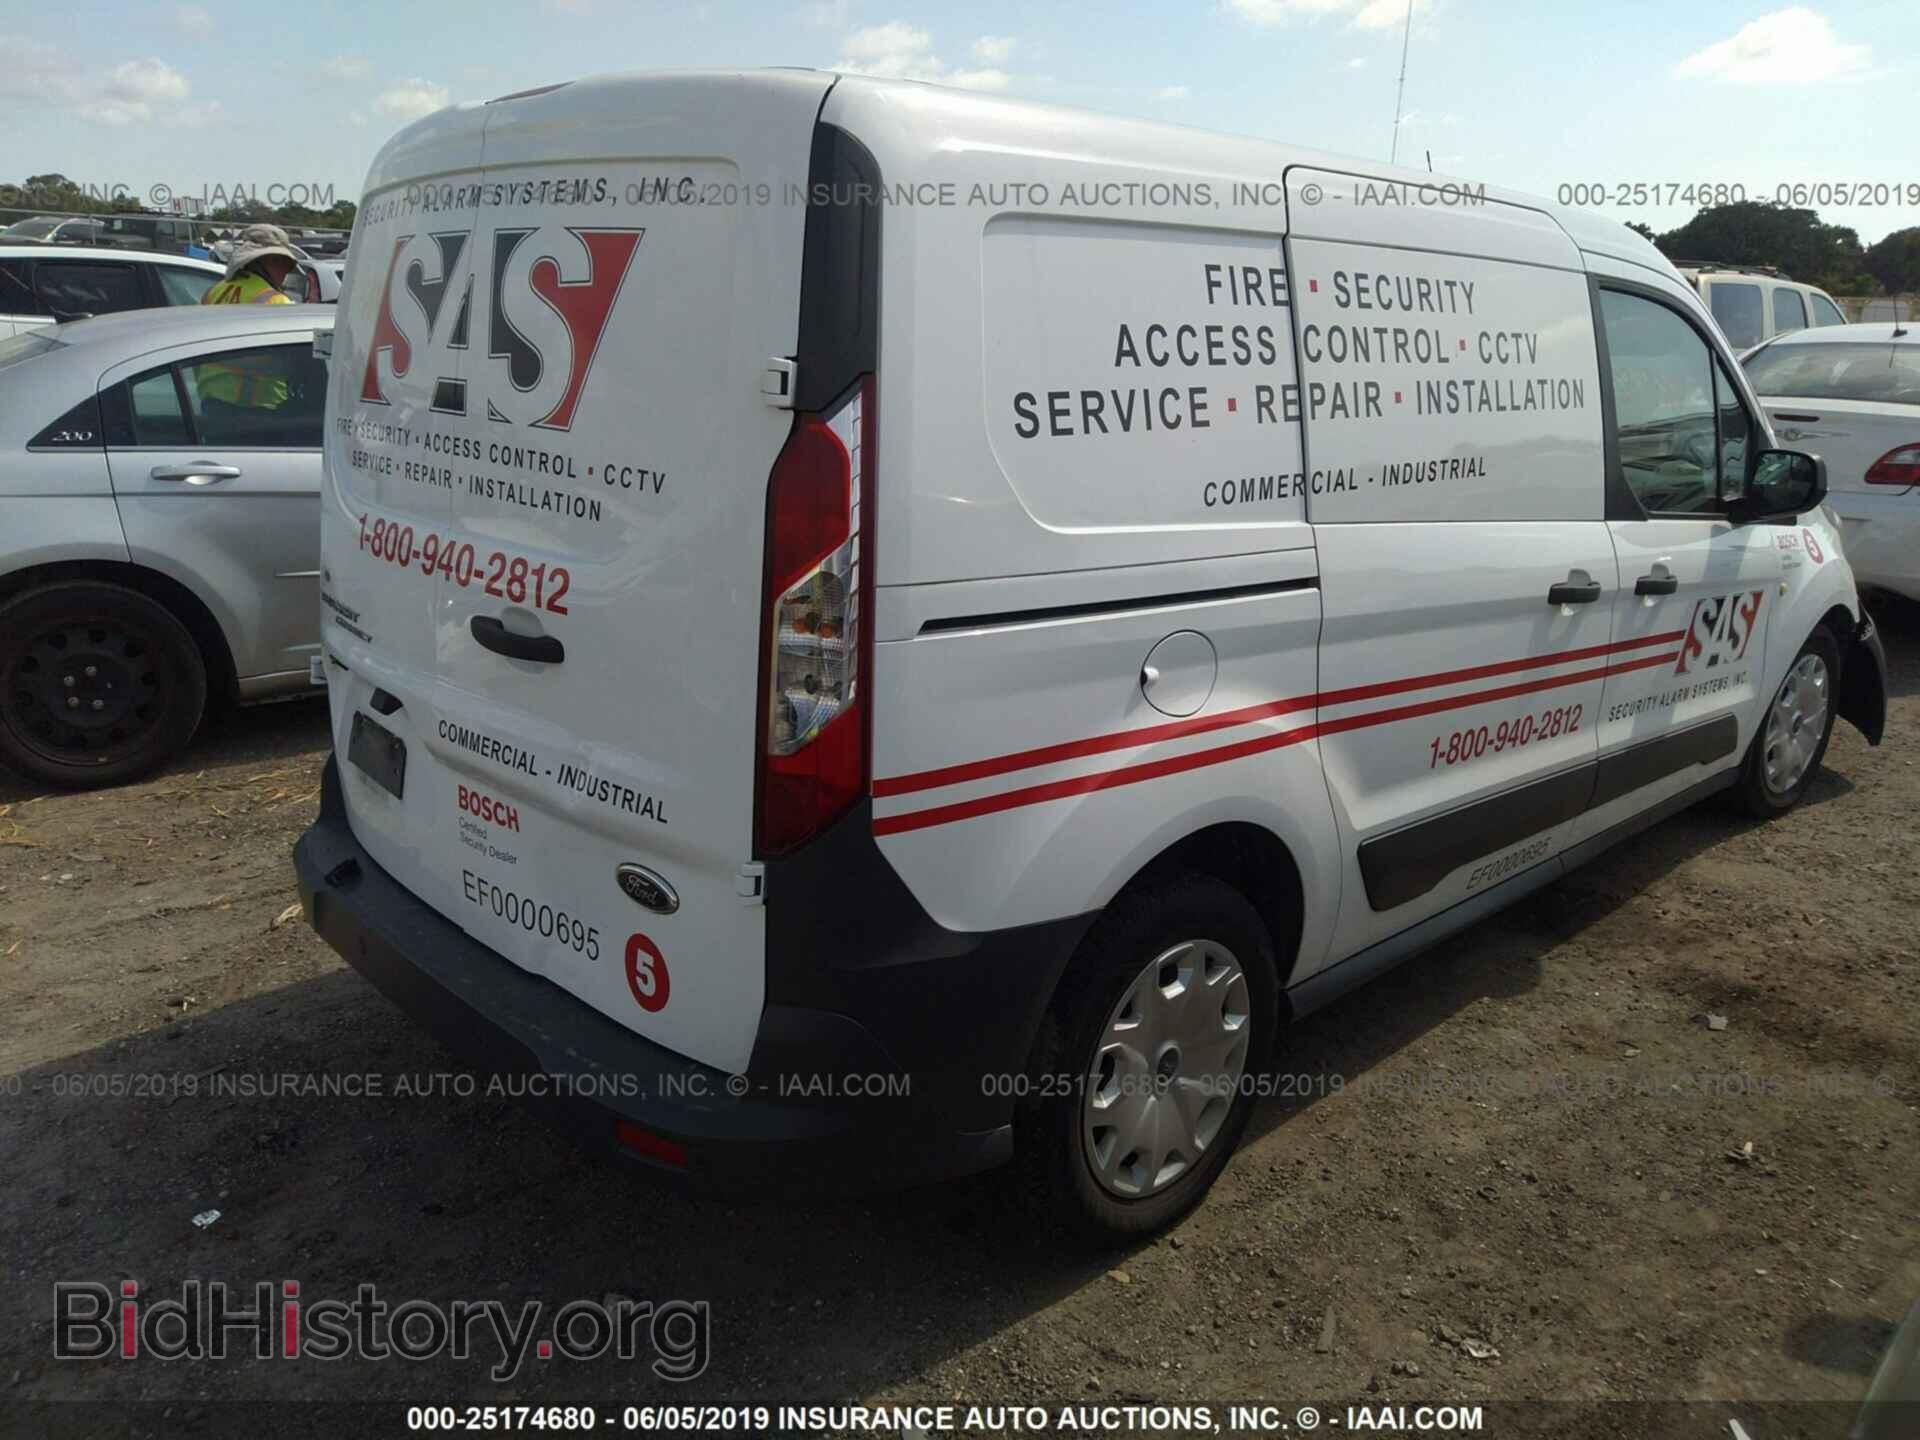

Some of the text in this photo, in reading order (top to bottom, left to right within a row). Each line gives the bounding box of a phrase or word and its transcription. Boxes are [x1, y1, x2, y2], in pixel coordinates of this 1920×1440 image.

[422, 185, 484, 214] ALARM
[493, 176, 617, 207] SYSTEMS,
[638, 176, 707, 206] INC.
[1204, 263, 1475, 315] FIRE SECURITY
[360, 228, 646, 433] SAS
[1114, 323, 1538, 367] ACCESS CONTROL CCTV
[1013, 378, 1585, 439] SERVICE REPAIR INSTALLATION
[335, 417, 666, 495] FIRE SECURITY ACCESS CONTROL CCTV
[351, 449, 601, 522] SERVICE REPAIR INSTALLATION
[1203, 464, 1358, 507] COMMERCIAL
[1382, 456, 1487, 487] INDUSTRIAL
[358, 512, 570, 615] 1-800-940-2812
[1673, 589, 1764, 678] SAS
[1430, 703, 1583, 769] 1-800-940-2812
[1608, 696, 1658, 723] SECURITY
[1659, 686, 1690, 707] ALARM
[438, 717, 539, 778] COMMERCIAL
[557, 763, 668, 824] INDUSTRIAL
[458, 784, 520, 832] BOSCH
[463, 869, 601, 963] EF0000695
[635, 948, 657, 997] 5
